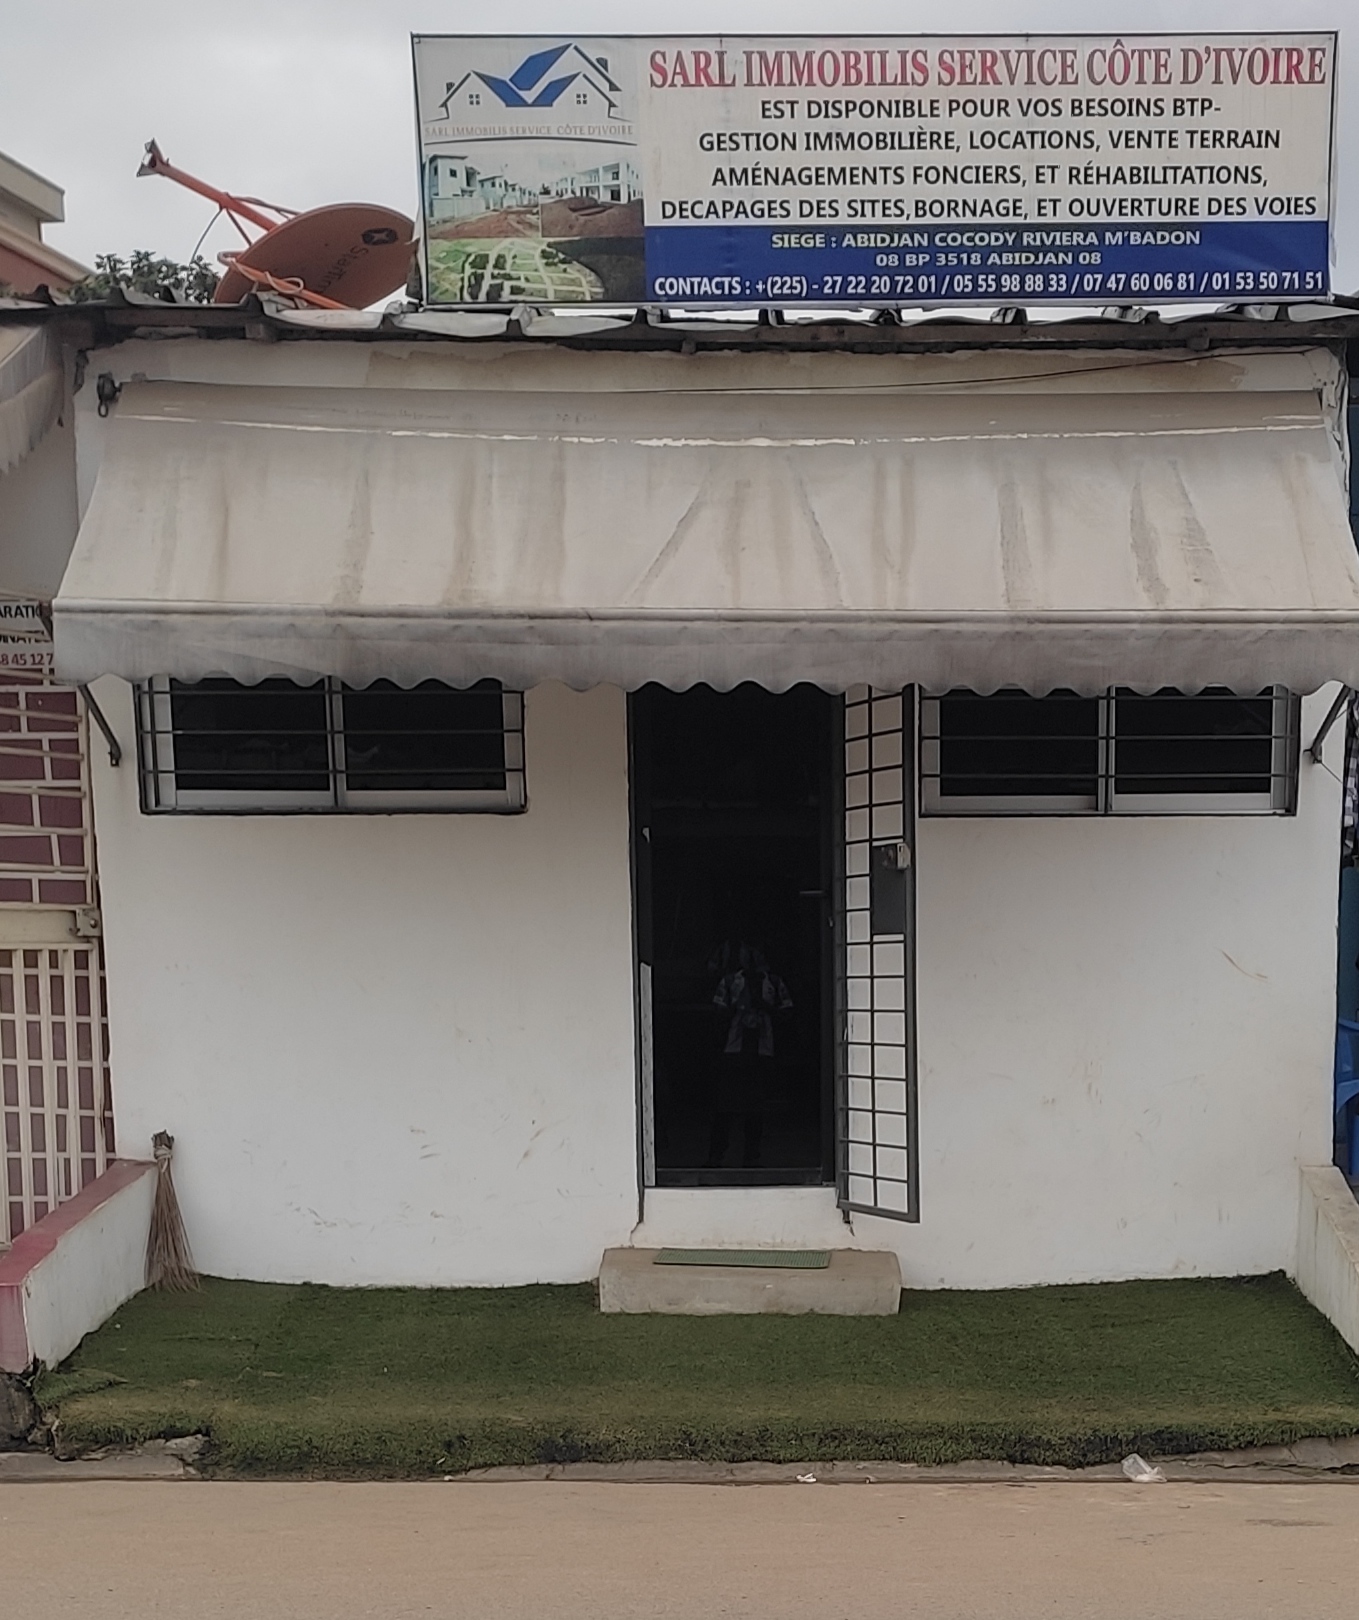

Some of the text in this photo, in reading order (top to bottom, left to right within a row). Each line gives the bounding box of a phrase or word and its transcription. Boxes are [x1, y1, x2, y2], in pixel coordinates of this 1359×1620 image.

[650, 50, 736, 87] SARL
[743, 50, 929, 86] IMMOBILIS
[937, 48, 1079, 86] SERVICE
[1087, 39, 1173, 85] CÔTE
[761, 98, 1222, 119] EST DISPONIBLE POUR VOS BESOINS BTP-
[699, 126, 1280, 154] GESTION IMMOBILIÈRE, LOCATIONS, VENTE TERRAIN
[712, 160, 1268, 187] AMÉNAGEMENTS FONCIERS, ET RÉHABILITATIONS,
[661, 200, 791, 220] DECAPAGES
[799, 200, 839, 218] DES
[1036, 199, 1061, 217] ET
[1068, 198, 1199, 217] OUVERTURE
[1207, 197, 1247, 216] DES
[1254, 197, 1316, 216] VOIES
[771, 234, 825, 249] SIEGE
[842, 233, 928, 248] ABIDJAN
[935, 232, 1016, 247] COCODY
[1022, 231, 1098, 247] RIVIERA
[876, 251, 1102, 267] 08 BP 3518 ABIDJAN 08
[654, 276, 741, 295] CONTACTS
[823, 277, 844, 294] 27
[847, 277, 867, 294] 22
[871, 277, 891, 294] 20
[895, 275, 916, 294] 72
[918, 275, 936, 293] 01
[953, 275, 974, 293] 05
[976, 275, 997, 293] 55
[1001, 275, 1021, 293] 98
[1024, 275, 1045, 292] 88
[1048, 274, 1067, 292] 33
[1083, 274, 1102, 292] 07
[1106, 274, 1127, 291] 47
[1131, 274, 1151, 291] 60
[1153, 273, 1173, 291] 06
[1176, 273, 1195, 291] 81
[1211, 273, 1231, 291] 01
[1235, 273, 1255, 291] 53
[1258, 273, 1279, 290] 50
[1283, 273, 1302, 290] 71
[1304, 273, 1323, 290] 51
